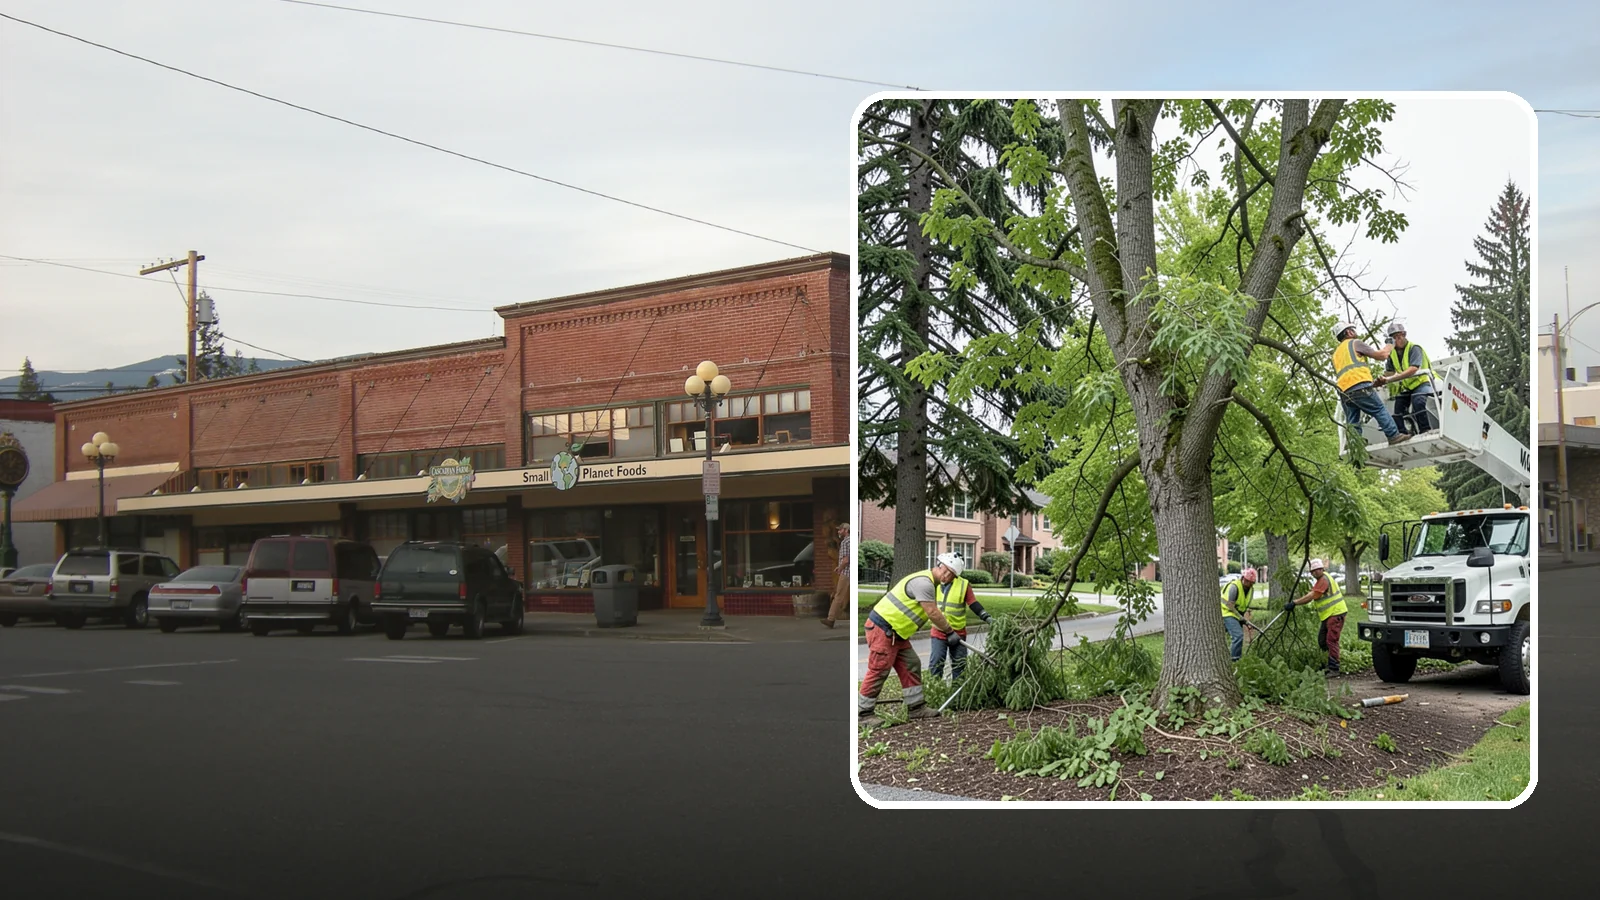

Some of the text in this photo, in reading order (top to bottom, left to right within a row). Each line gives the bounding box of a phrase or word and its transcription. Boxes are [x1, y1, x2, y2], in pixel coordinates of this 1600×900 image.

[523, 464, 647, 484] Small Planet Foods
